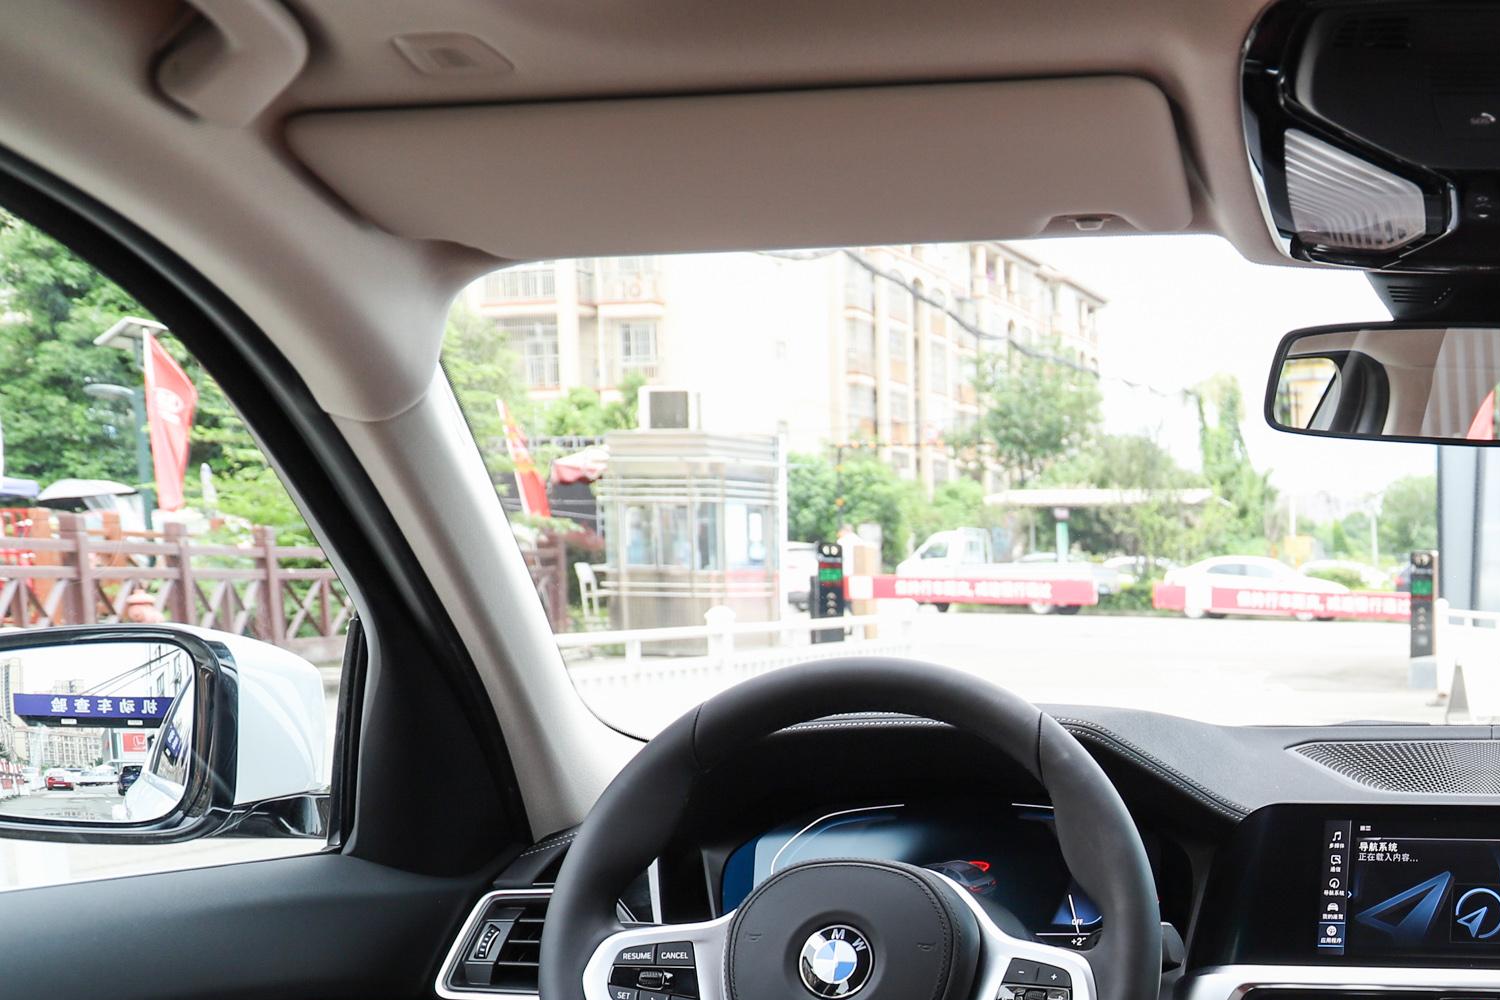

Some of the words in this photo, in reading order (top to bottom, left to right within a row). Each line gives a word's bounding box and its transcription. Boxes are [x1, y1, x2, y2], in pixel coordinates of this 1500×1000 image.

[1358, 841, 1399, 852] 导航系统
[622, 951, 652, 961] RESUME
[660, 951, 689, 960] CANCEL
[616, 991, 631, 1000] SET
